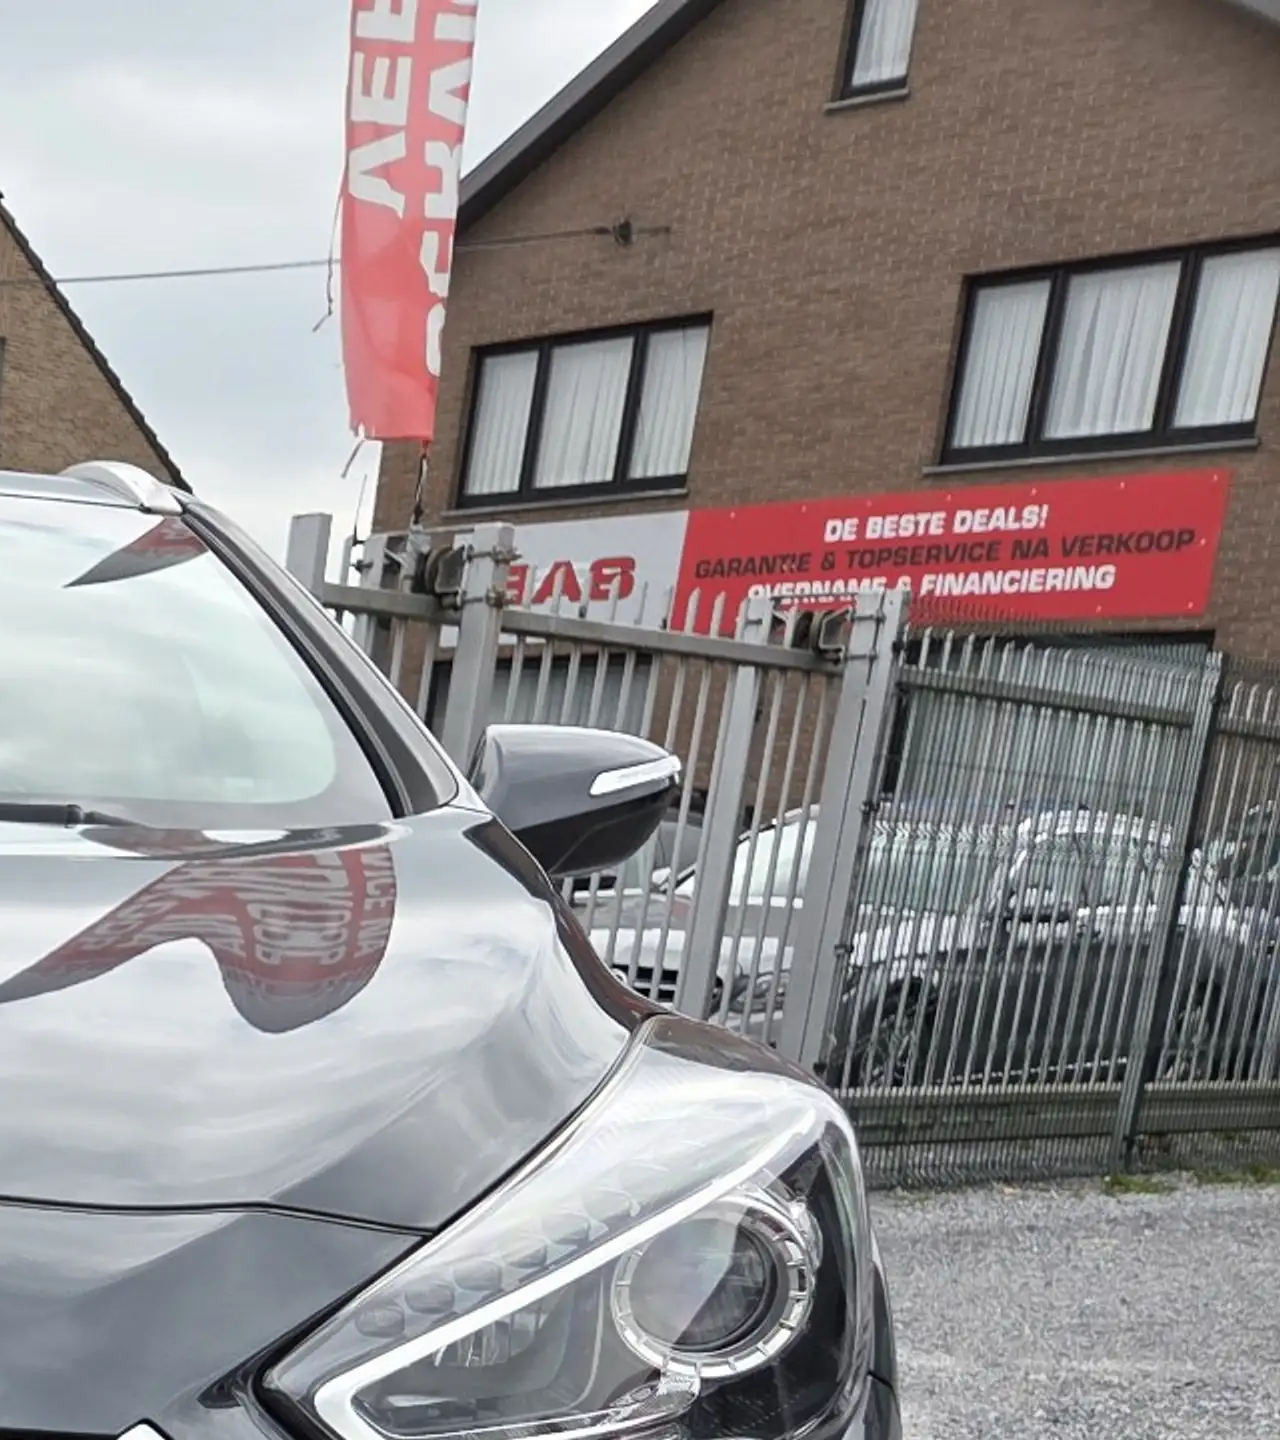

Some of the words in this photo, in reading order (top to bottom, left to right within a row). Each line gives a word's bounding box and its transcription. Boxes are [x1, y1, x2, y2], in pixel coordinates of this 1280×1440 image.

[823, 518, 858, 543] DE
[865, 511, 946, 540] BESTE
[953, 504, 1049, 534] DEALS!
[695, 552, 811, 579] GARANTIE
[821, 551, 836, 571] &
[847, 539, 1001, 569] TOPSERVICE
[1011, 538, 1050, 561] NA
[1061, 529, 1196, 558] VERKOOP
[920, 564, 1116, 597] FINANCIERING
